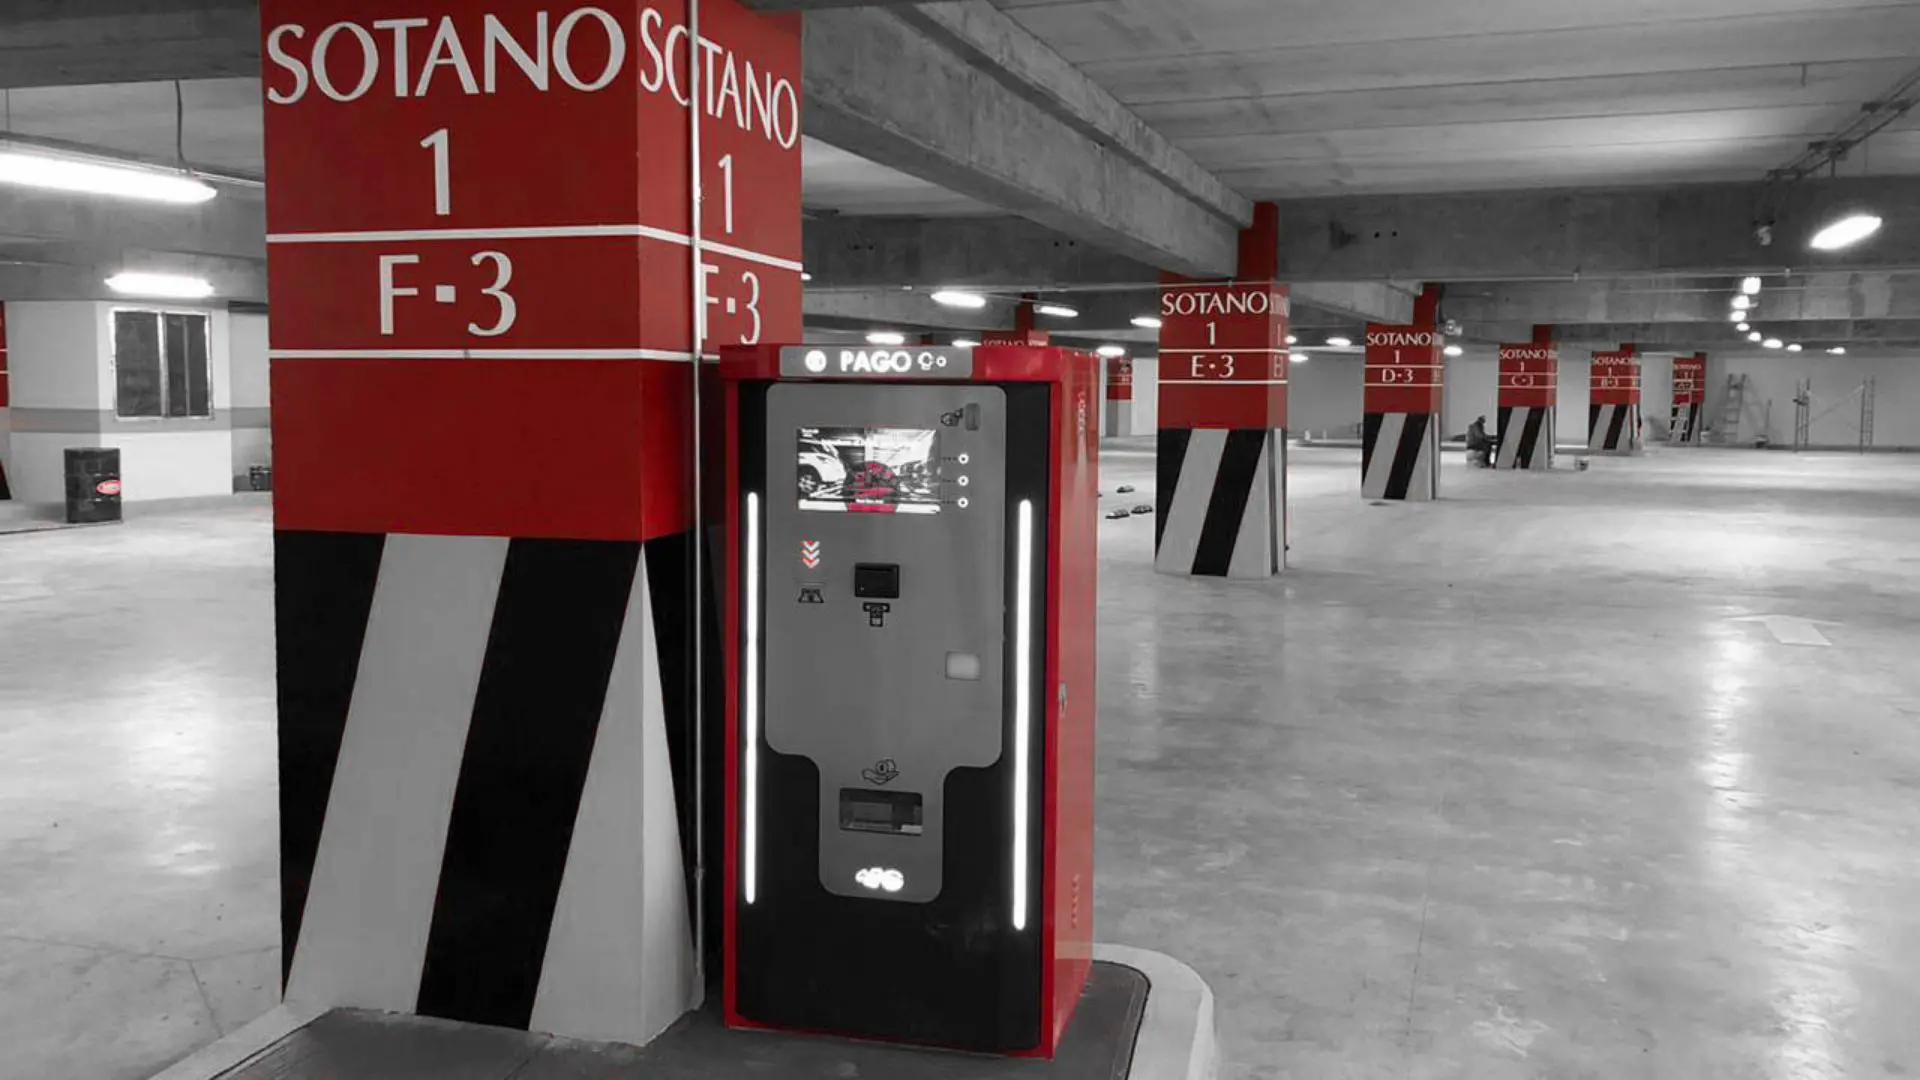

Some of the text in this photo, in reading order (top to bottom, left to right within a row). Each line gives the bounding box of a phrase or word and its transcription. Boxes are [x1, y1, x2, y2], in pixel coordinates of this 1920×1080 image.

[267, 6, 627, 105] SOTANO
[640, 7, 799, 150] SOTANO
[420, 128, 452, 216] 1
[717, 154, 733, 233] 1
[1161, 291, 1269, 316] SOTANO
[1206, 321, 1216, 346] 1
[1366, 331, 1432, 347] SOTANO
[840, 350, 913, 373] PAGO
[1394, 349, 1401, 364] 1
[1500, 348, 1549, 360] SOTANO
